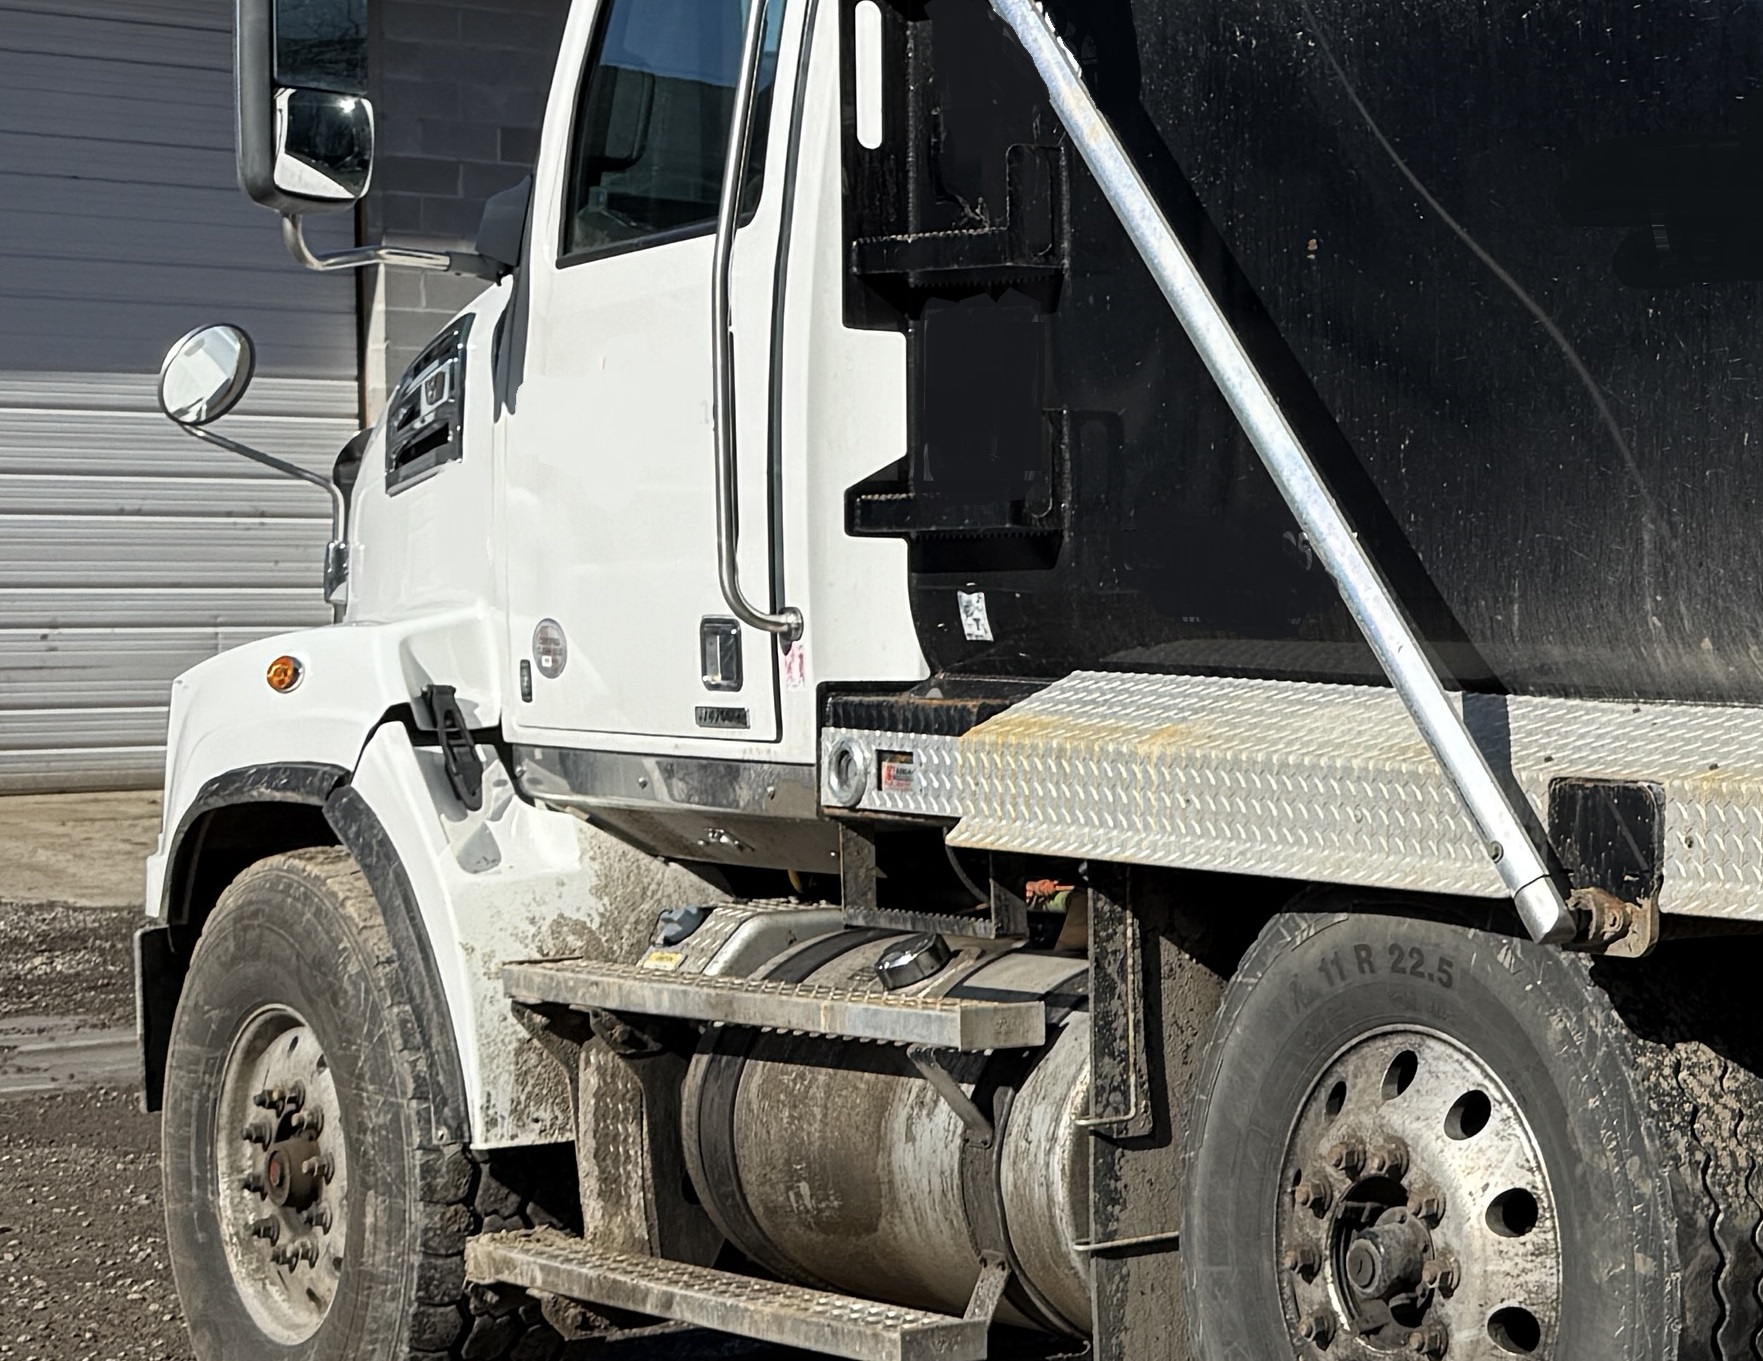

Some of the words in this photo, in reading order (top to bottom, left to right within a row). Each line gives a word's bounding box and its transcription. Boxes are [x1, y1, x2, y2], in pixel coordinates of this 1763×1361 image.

[1318, 951, 1347, 986] 11
[1354, 943, 1375, 974] R
[1388, 942, 1454, 989] 22.5
